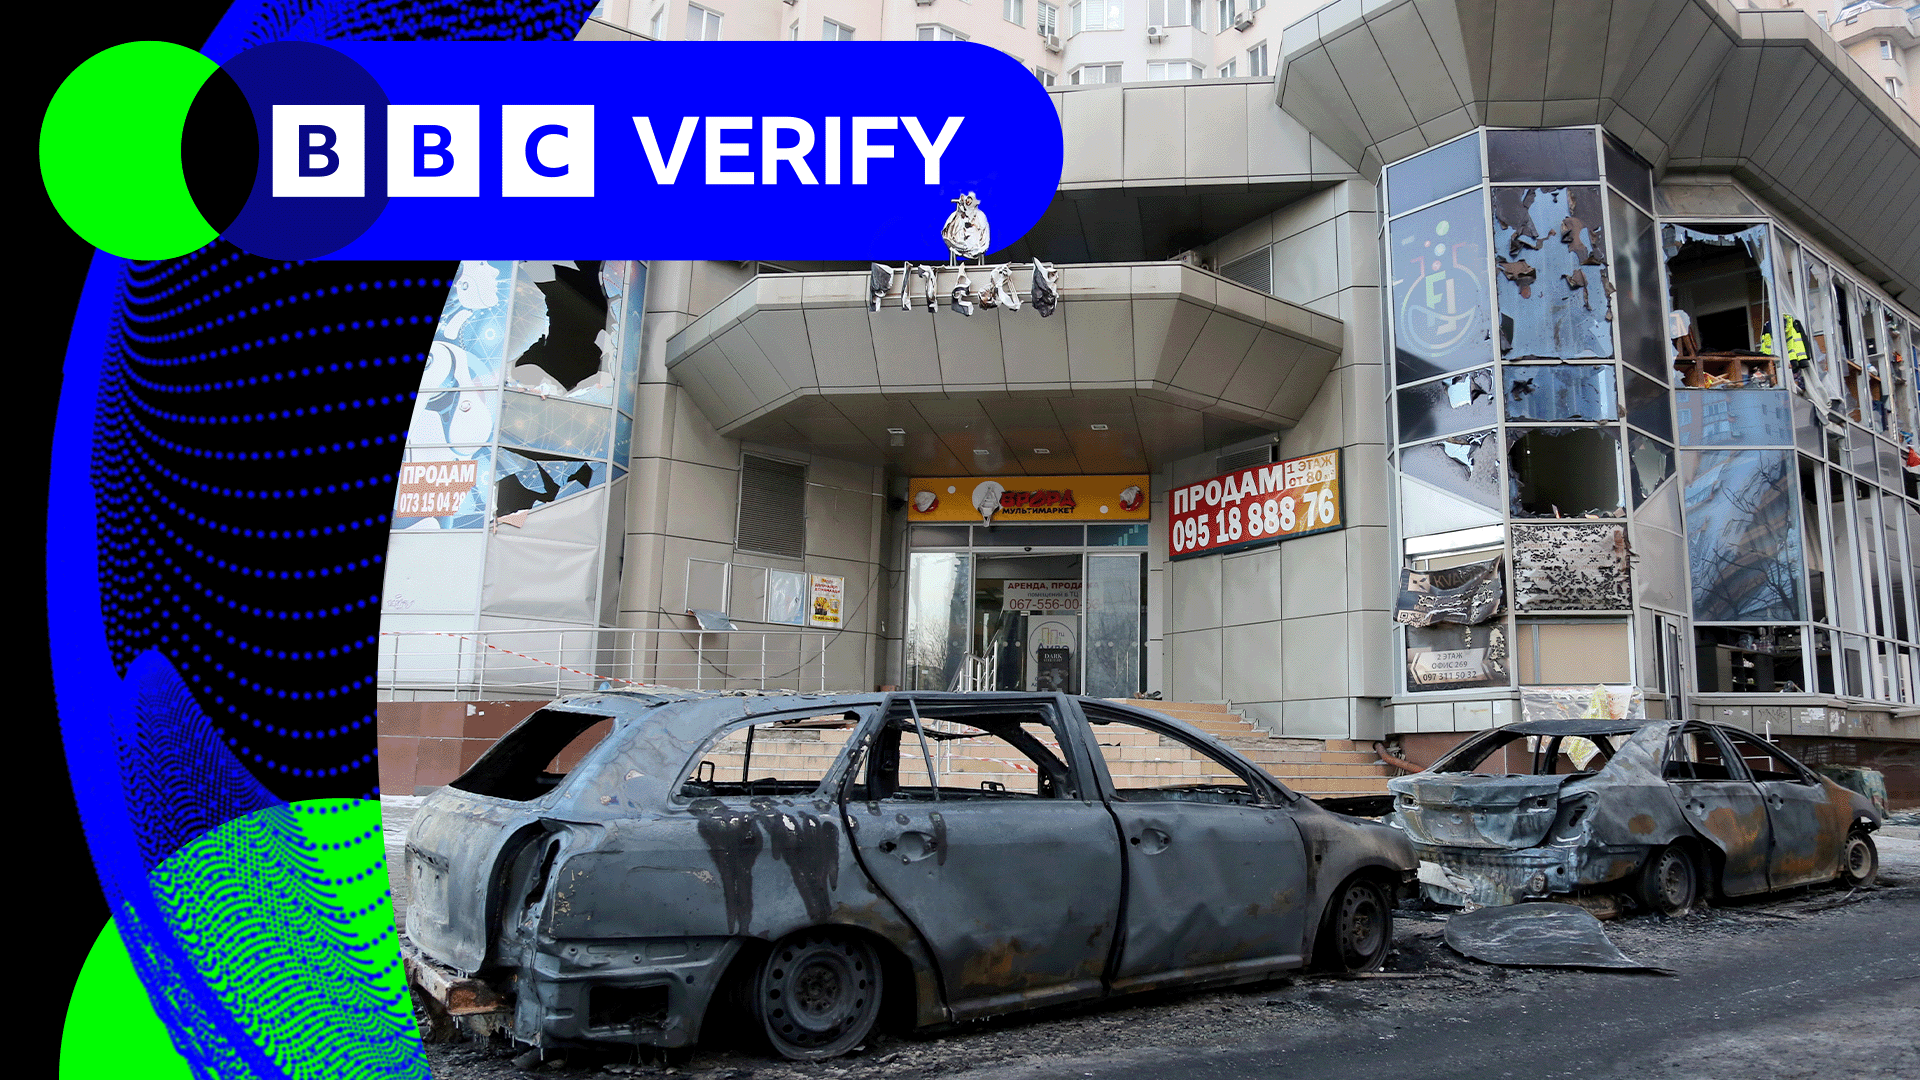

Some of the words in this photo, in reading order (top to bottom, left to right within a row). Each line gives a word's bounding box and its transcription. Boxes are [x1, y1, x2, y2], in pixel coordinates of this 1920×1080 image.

[1286, 464, 1295, 474] 1
[1298, 455, 1333, 472] ЭТАЖ
[402, 464, 476, 487] ПРОДАМ
[1306, 470, 1323, 484] 80
[1174, 464, 1284, 516] ПРОДАМ
[399, 493, 420, 513] 073
[421, 492, 436, 512] 15
[437, 491, 451, 512] 04
[1002, 507, 1075, 515] МУЛЬТИМАРКЕТ
[1172, 514, 1210, 552] 095
[1216, 506, 1243, 544] 18
[1247, 496, 1297, 537] 888
[1302, 488, 1335, 528] 76
[1007, 582, 1049, 590] АРЕНДА,
[1423, 673, 1437, 681] 097
[1439, 672, 1453, 680] 311
